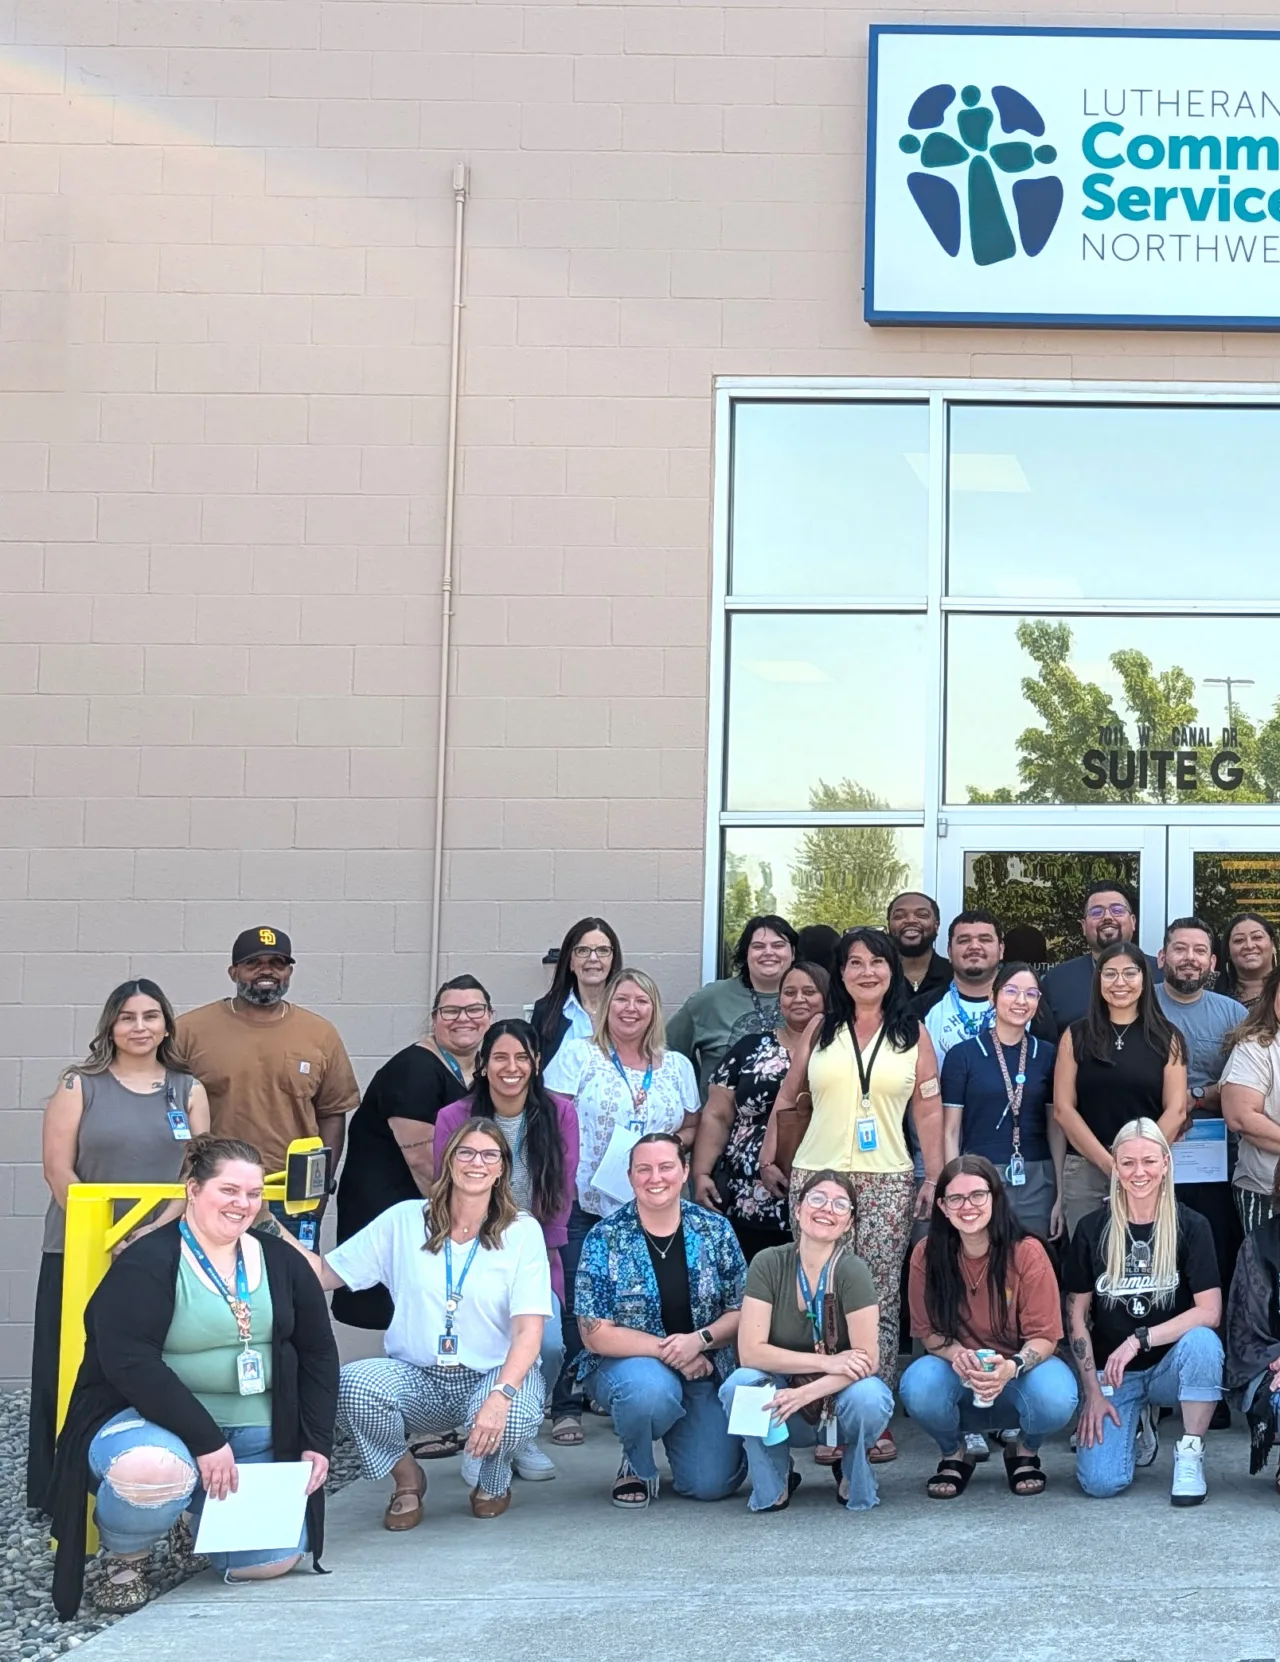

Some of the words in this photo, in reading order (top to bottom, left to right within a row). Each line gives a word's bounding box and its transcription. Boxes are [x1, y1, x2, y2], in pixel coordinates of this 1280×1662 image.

[1137, 726, 1150, 747] W
[1172, 727, 1213, 747] CANAL
[1082, 750, 1198, 790] SUITE
[1211, 751, 1244, 790] G
[1096, 1272, 1180, 1293] Campins
[1132, 1297, 1146, 1315] LA
